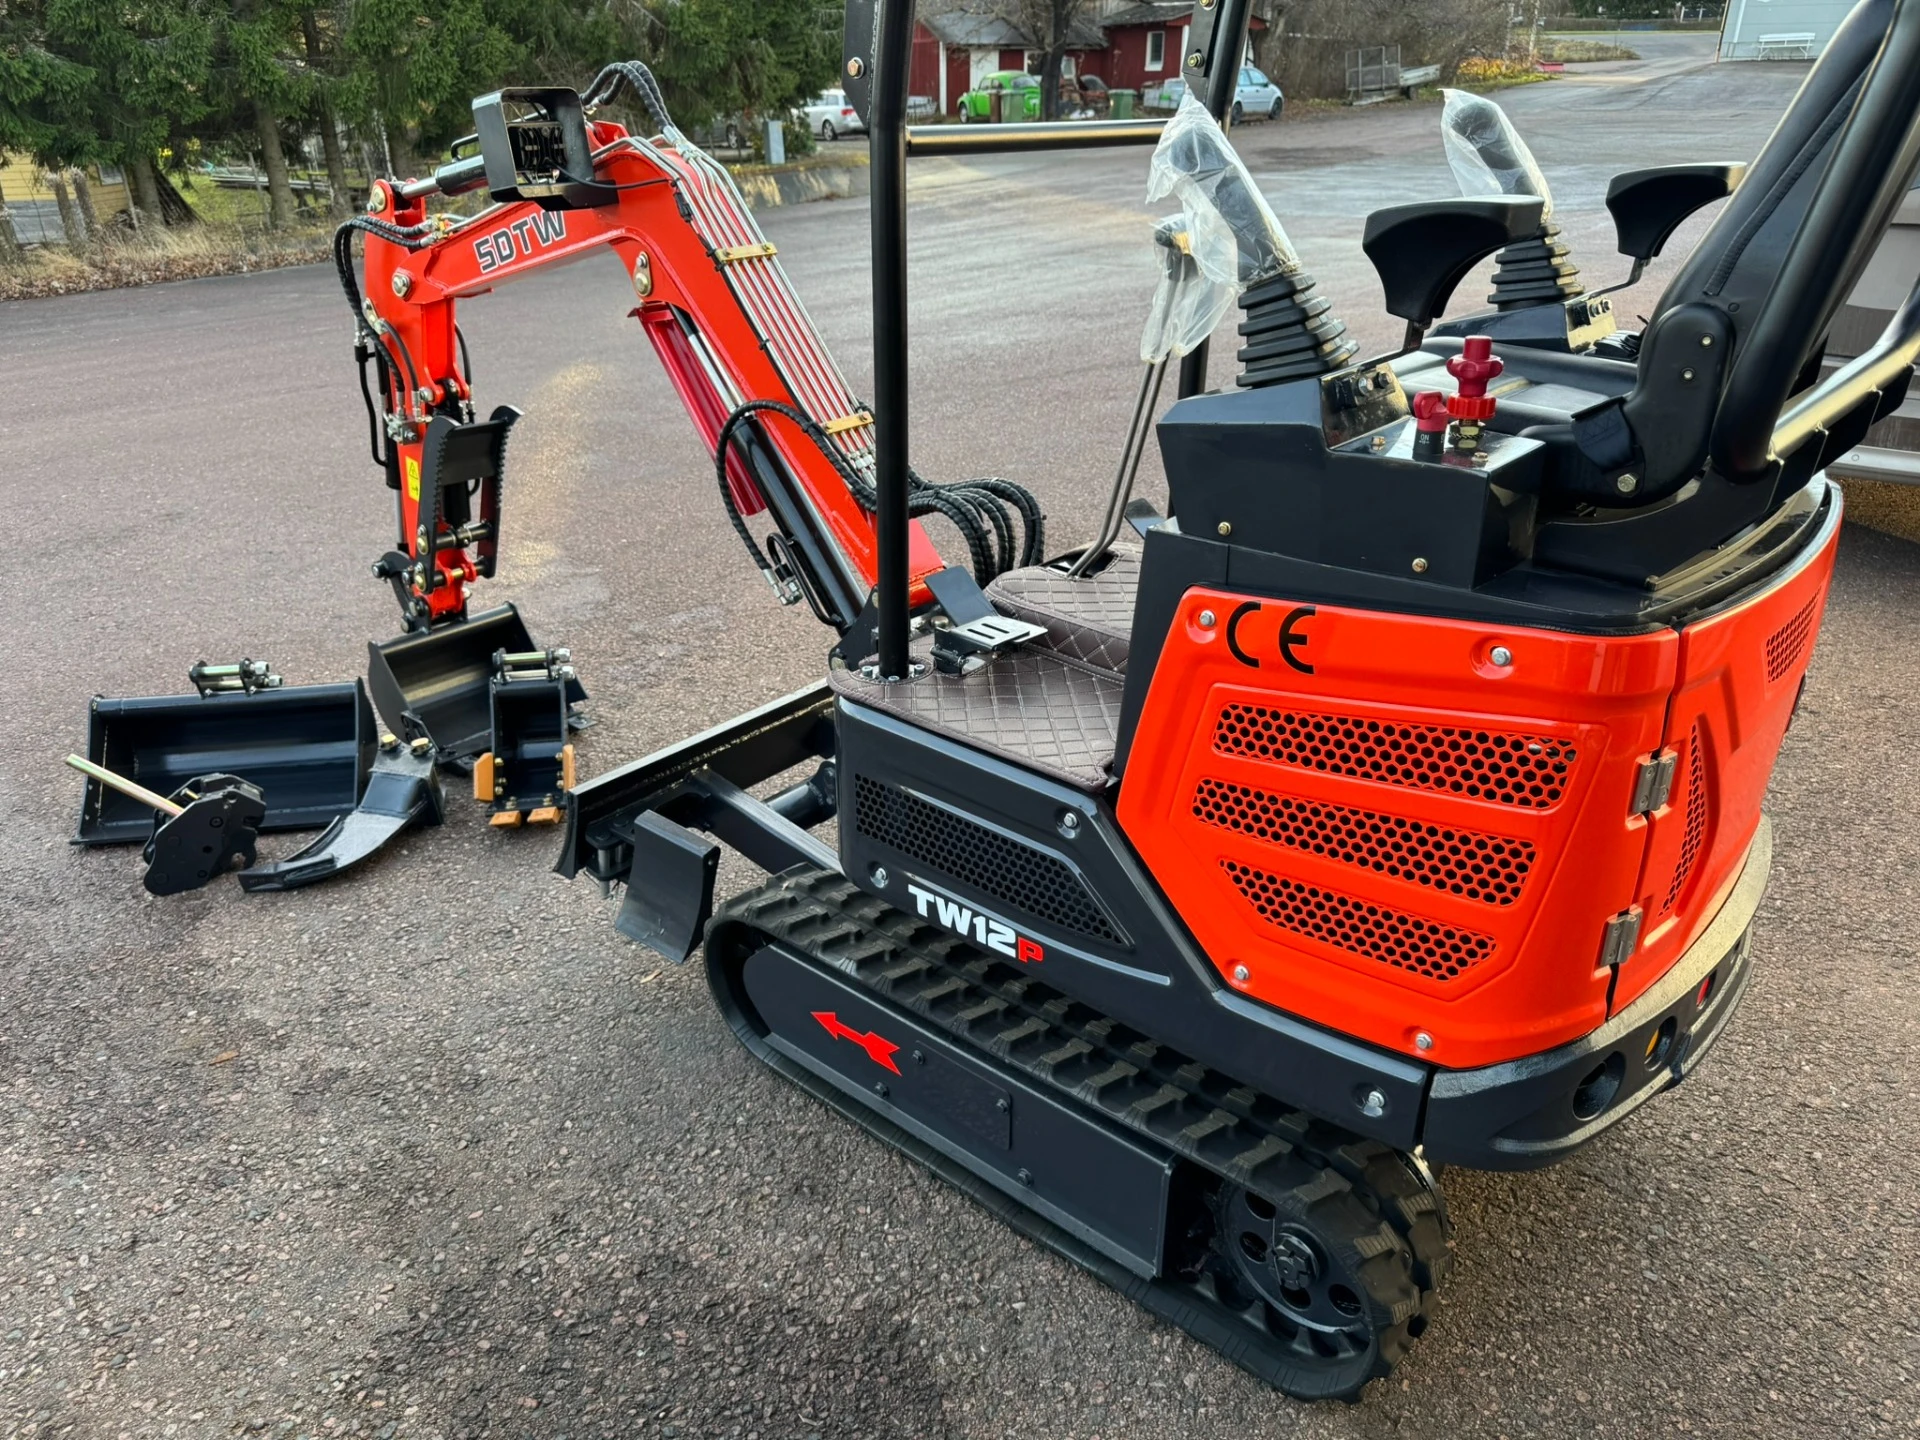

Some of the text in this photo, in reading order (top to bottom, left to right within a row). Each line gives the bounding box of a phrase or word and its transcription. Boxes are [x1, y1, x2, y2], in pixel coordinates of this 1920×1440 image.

[473, 208, 566, 274] SDTW
[1226, 600, 1316, 675] CE
[907, 883, 1045, 963] TW12P
